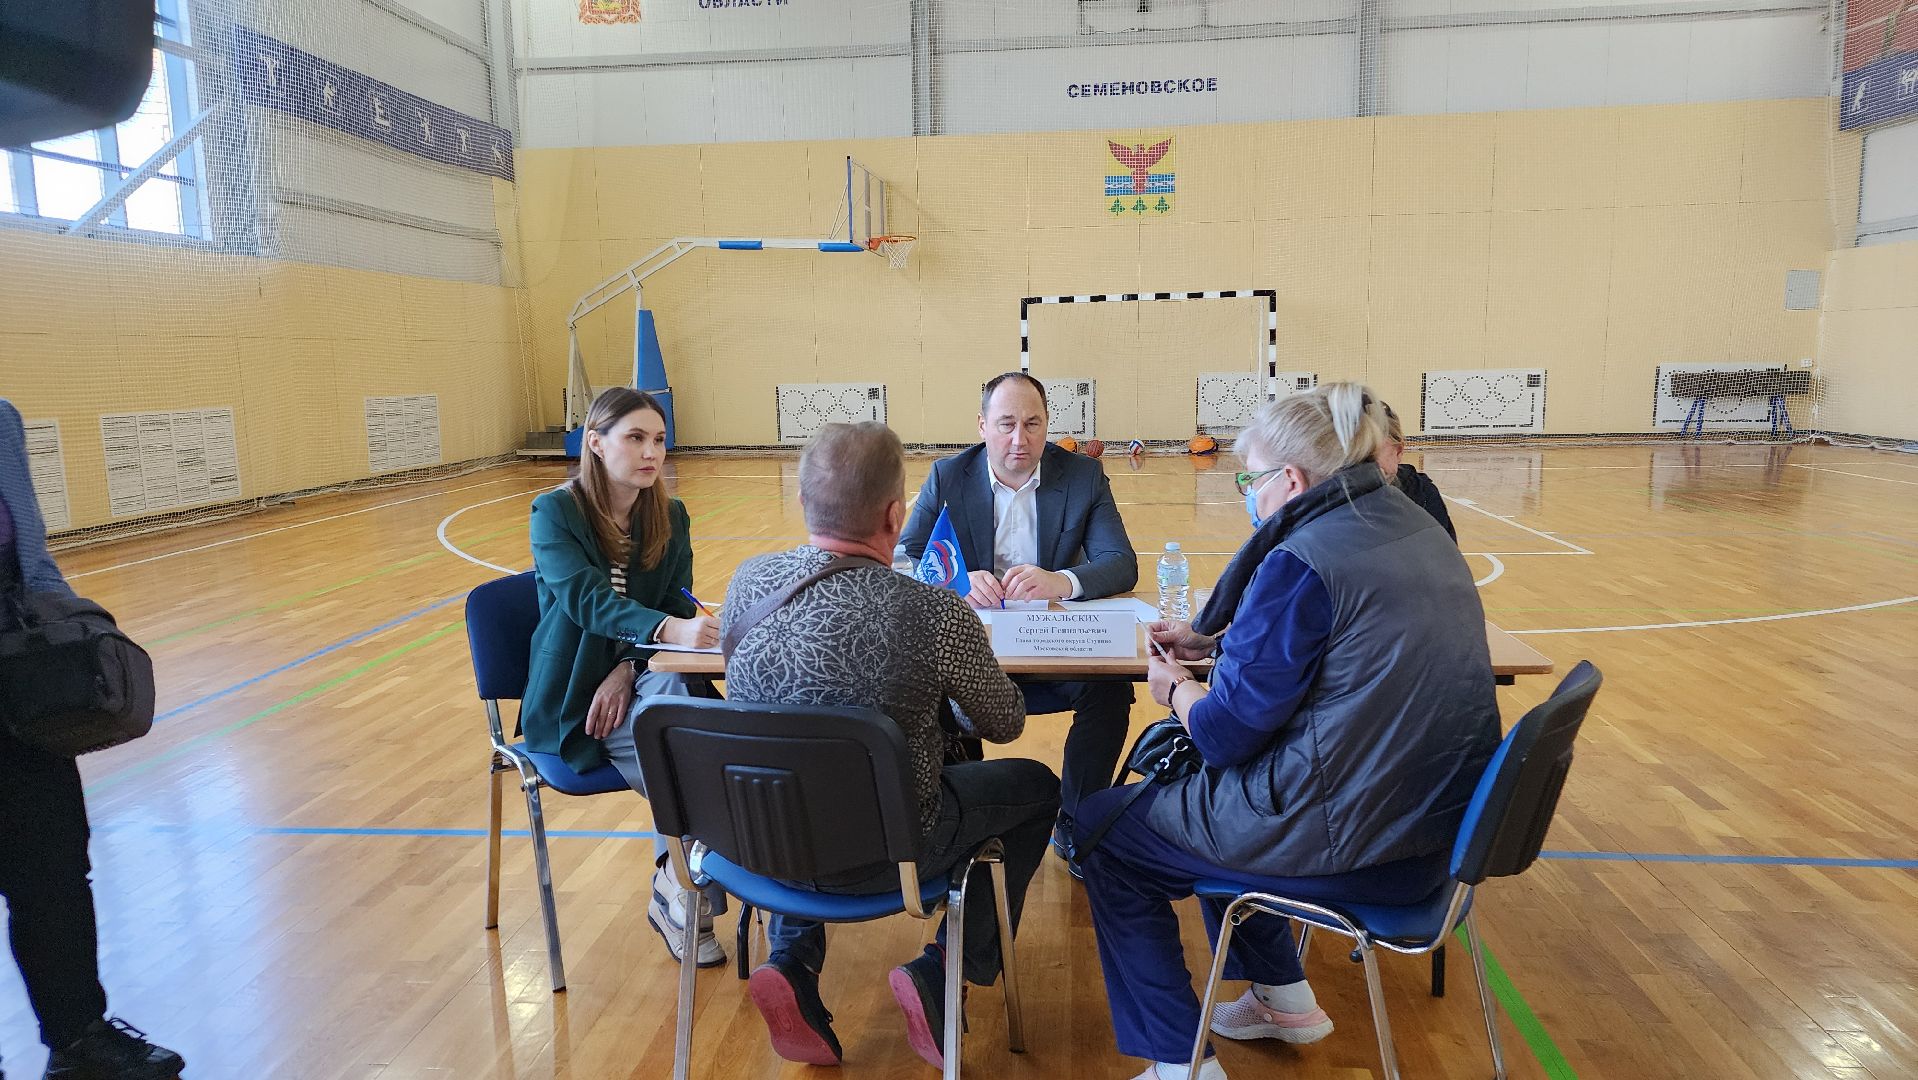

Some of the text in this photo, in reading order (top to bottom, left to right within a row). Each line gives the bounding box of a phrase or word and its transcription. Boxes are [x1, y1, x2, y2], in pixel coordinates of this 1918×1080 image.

[1067, 77, 1218, 99] СЕМЕНОВСКОЕ
[1026, 614, 1100, 622] МУЖАЛЬСКИХ
[1018, 626, 1049, 635] Сергей
